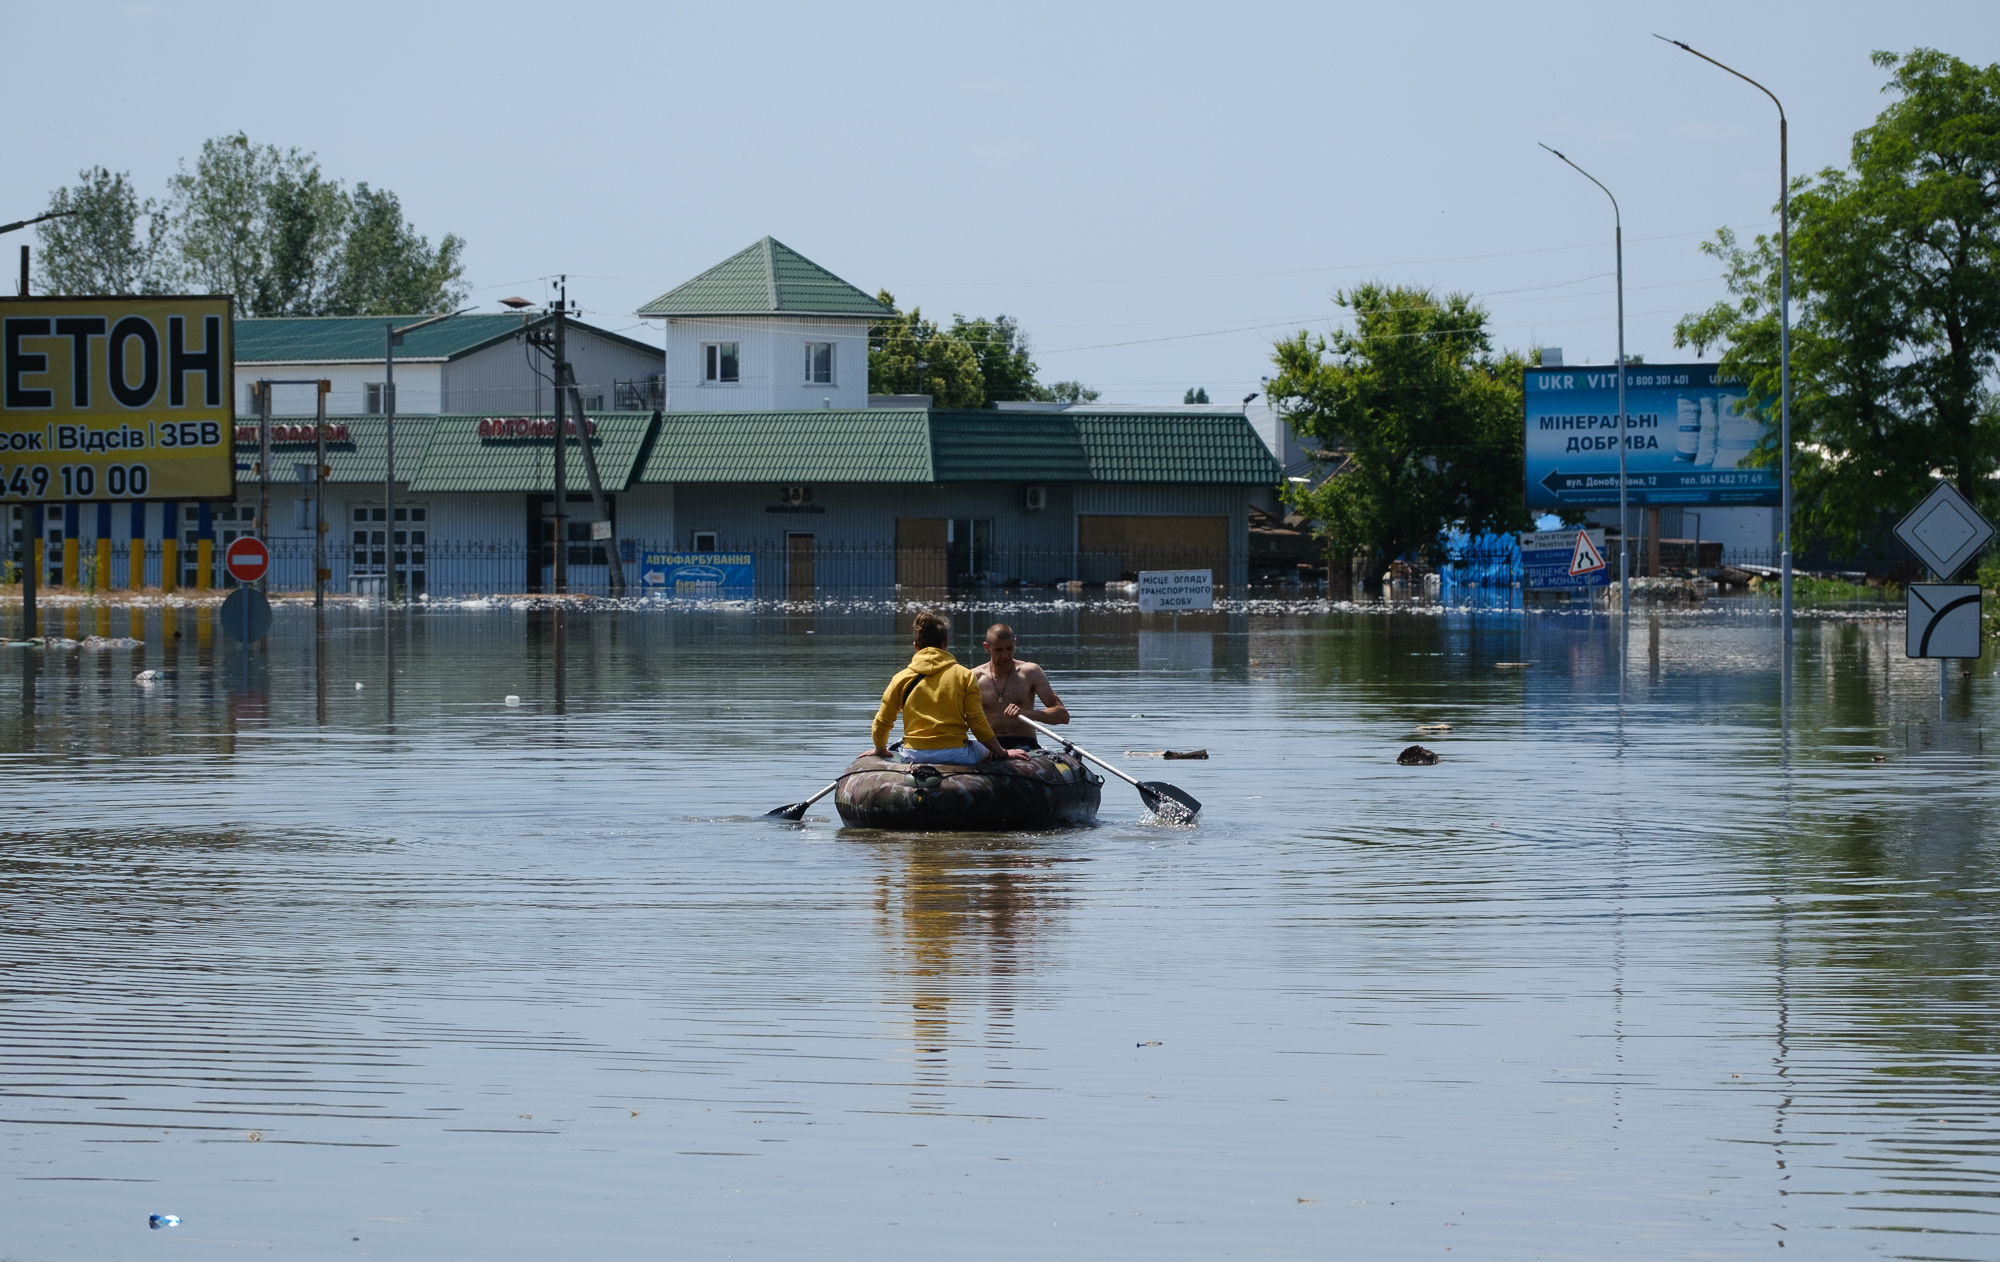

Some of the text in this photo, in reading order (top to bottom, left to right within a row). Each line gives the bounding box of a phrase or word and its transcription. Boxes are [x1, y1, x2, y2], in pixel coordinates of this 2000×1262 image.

[4, 316, 221, 409] ЕТОН
[1538, 374, 1618, 390] UKRAVIT
[1627, 374, 1689, 386] 0 800 301 401
[1540, 414, 1658, 430] МІНЕРАЛЬНІ
[57, 424, 145, 453] Відсів
[160, 422, 220, 447] ЗБВ
[1566, 435, 1659, 453] ДОБРИВА
[61, 466, 94, 496] 10
[108, 465, 147, 495] 00
[1566, 479, 1584, 489] вул.
[1648, 476, 1657, 486] 12
[1680, 474, 1762, 485] тел. 067 482 77 49
[646, 555, 751, 565] АВТОФАРБУВАННЯ
[1174, 575, 1208, 585] ОГЛЯДУ
[1141, 586, 1211, 596] ТРАНСПОРТНОГО
[1160, 598, 1192, 606] ЗАСОБУ
